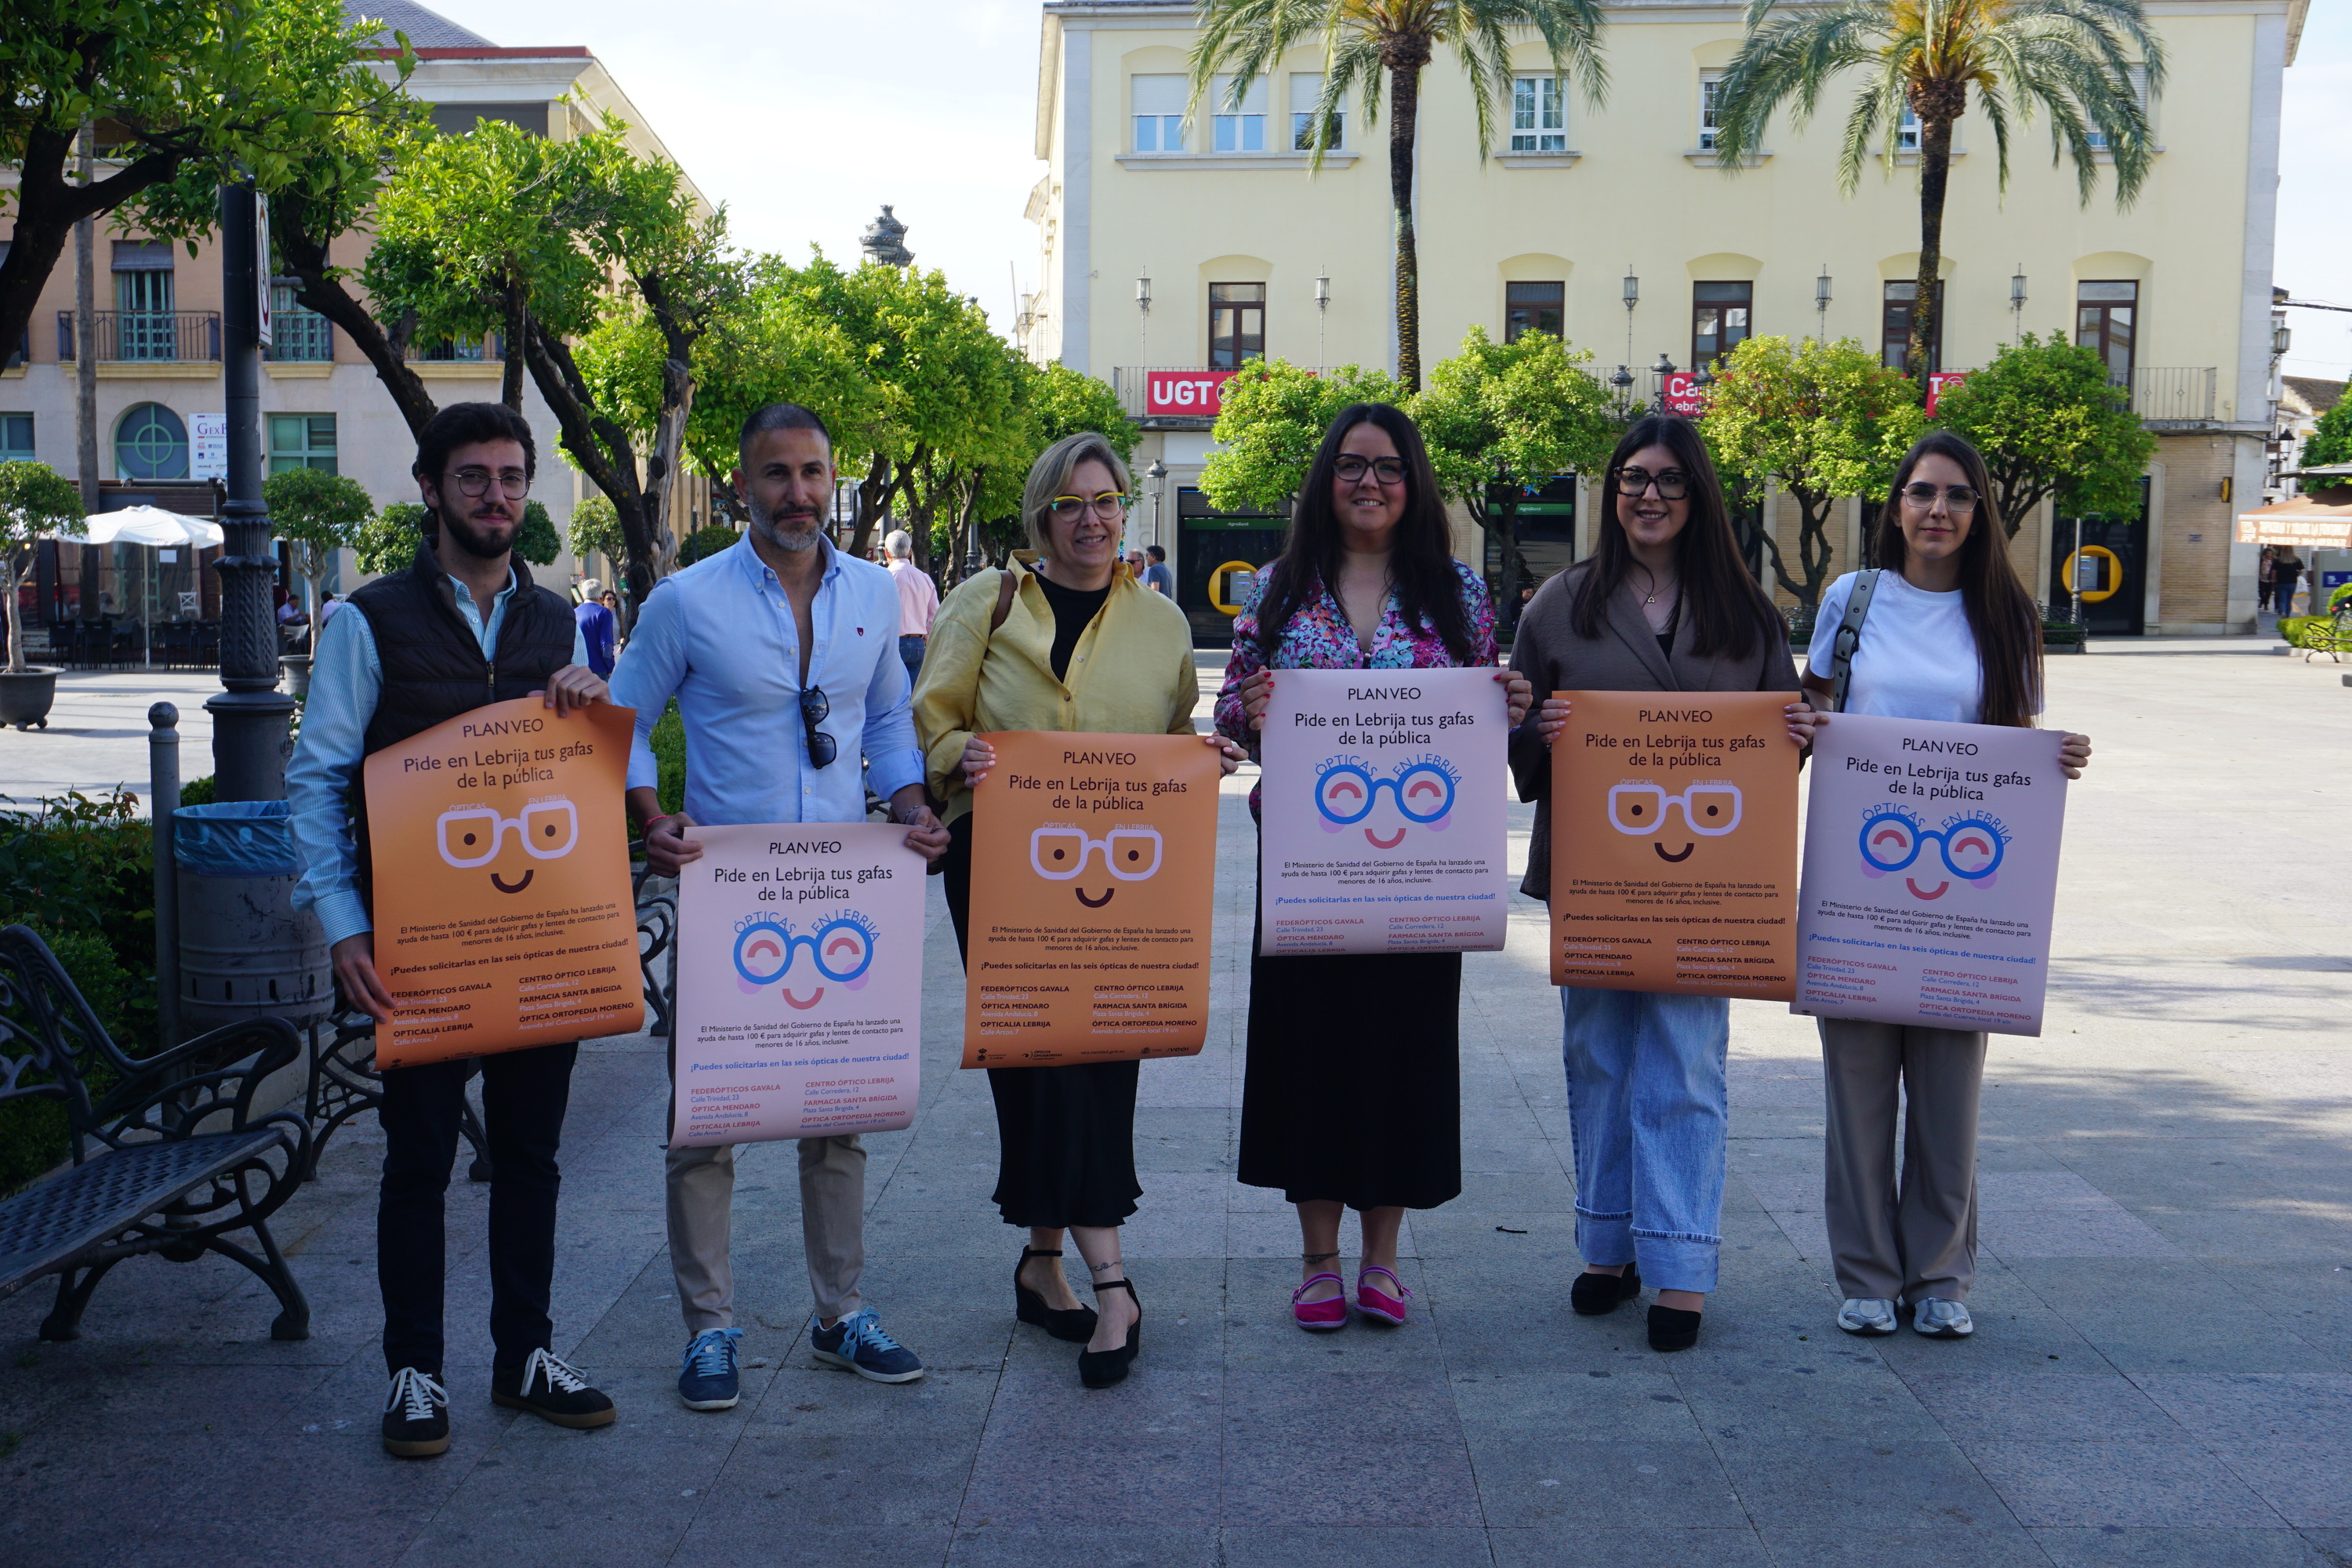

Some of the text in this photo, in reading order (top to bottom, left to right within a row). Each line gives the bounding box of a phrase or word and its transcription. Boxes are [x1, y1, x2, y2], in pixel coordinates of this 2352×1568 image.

[1153, 380, 1213, 405] UGT
[1348, 688, 1421, 700] PLAN VEO
[1295, 711, 1474, 730] Pide en Lebrija tus gafas
[1639, 710, 1712, 723] PLAN VEO
[463, 718, 543, 738] PLAN VEO
[1339, 731, 1431, 749] de la pública
[1586, 734, 1766, 752] Pide en Lebrija tus gafas
[1903, 738, 1978, 756] PLAN VEO
[405, 741, 593, 772] Pide en Lebrija tus gafas
[1064, 752, 1136, 765] PLAN VEO
[1629, 752, 1722, 770] de la pública
[1392, 757, 1412, 776] EN
[1847, 757, 2031, 788] Pide en Lebrija tus gafas
[457, 767, 554, 789] de la pública
[1010, 775, 1187, 797] Pide en Lebrija tus gafas
[1889, 780, 1984, 800] de la pública
[1053, 794, 1144, 814] de la pública
[770, 841, 841, 855] PLAN VEO
[715, 865, 892, 884] Pide en Lebrija tus gafas
[758, 885, 850, 904] de la pública
[1276, 897, 1307, 906] ¡Puedes
[1394, 895, 1422, 903] ópticas
[390, 965, 426, 976] ¡Puedes
[429, 959, 476, 971] solicitarlas
[524, 950, 554, 960] ópticas
[569, 945, 600, 954] nuestra
[602, 938, 628, 949] ciudad!
[1808, 956, 1897, 971] FEDERÓPTICOS GAVALA
[1822, 964, 1846, 973] Trinidad,
[1807, 971, 1876, 985] ÓPTICA MENDARO
[1806, 989, 1877, 1003] OPTICALIA LEBRIJA
[691, 1086, 749, 1094] FEDERÓPTICOS
